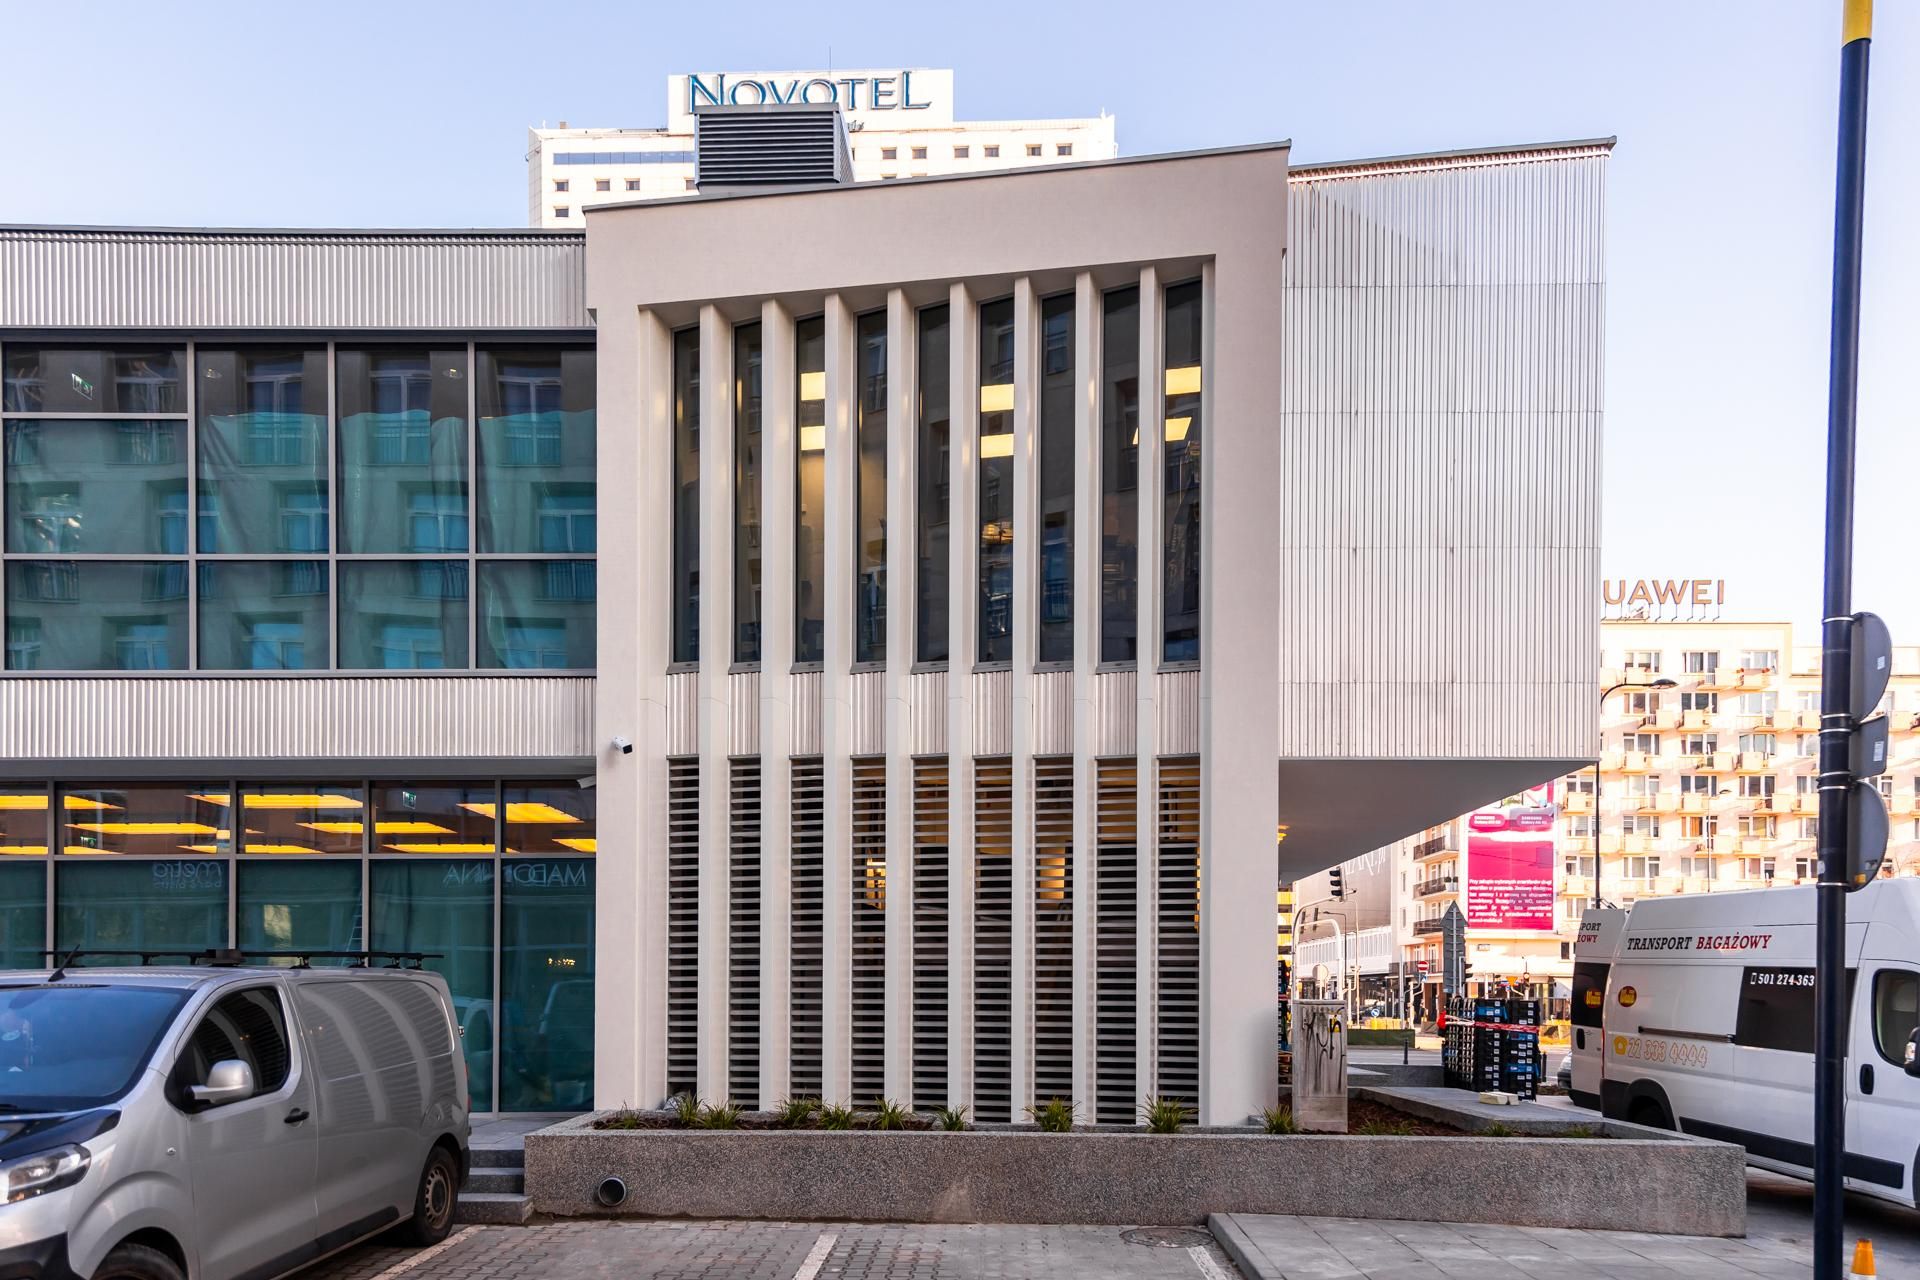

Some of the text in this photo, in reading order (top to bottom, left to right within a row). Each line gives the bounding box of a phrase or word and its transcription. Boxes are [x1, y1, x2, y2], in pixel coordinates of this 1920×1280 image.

[687, 70, 932, 114] NOVOTEL
[1603, 579, 1725, 605] UAWEI
[1627, 931, 1772, 950] TRANSPORT BAGAŻOWY
[1757, 973, 1815, 987] 501 274 363
[1628, 1037, 1708, 1069] 22 333 4444
